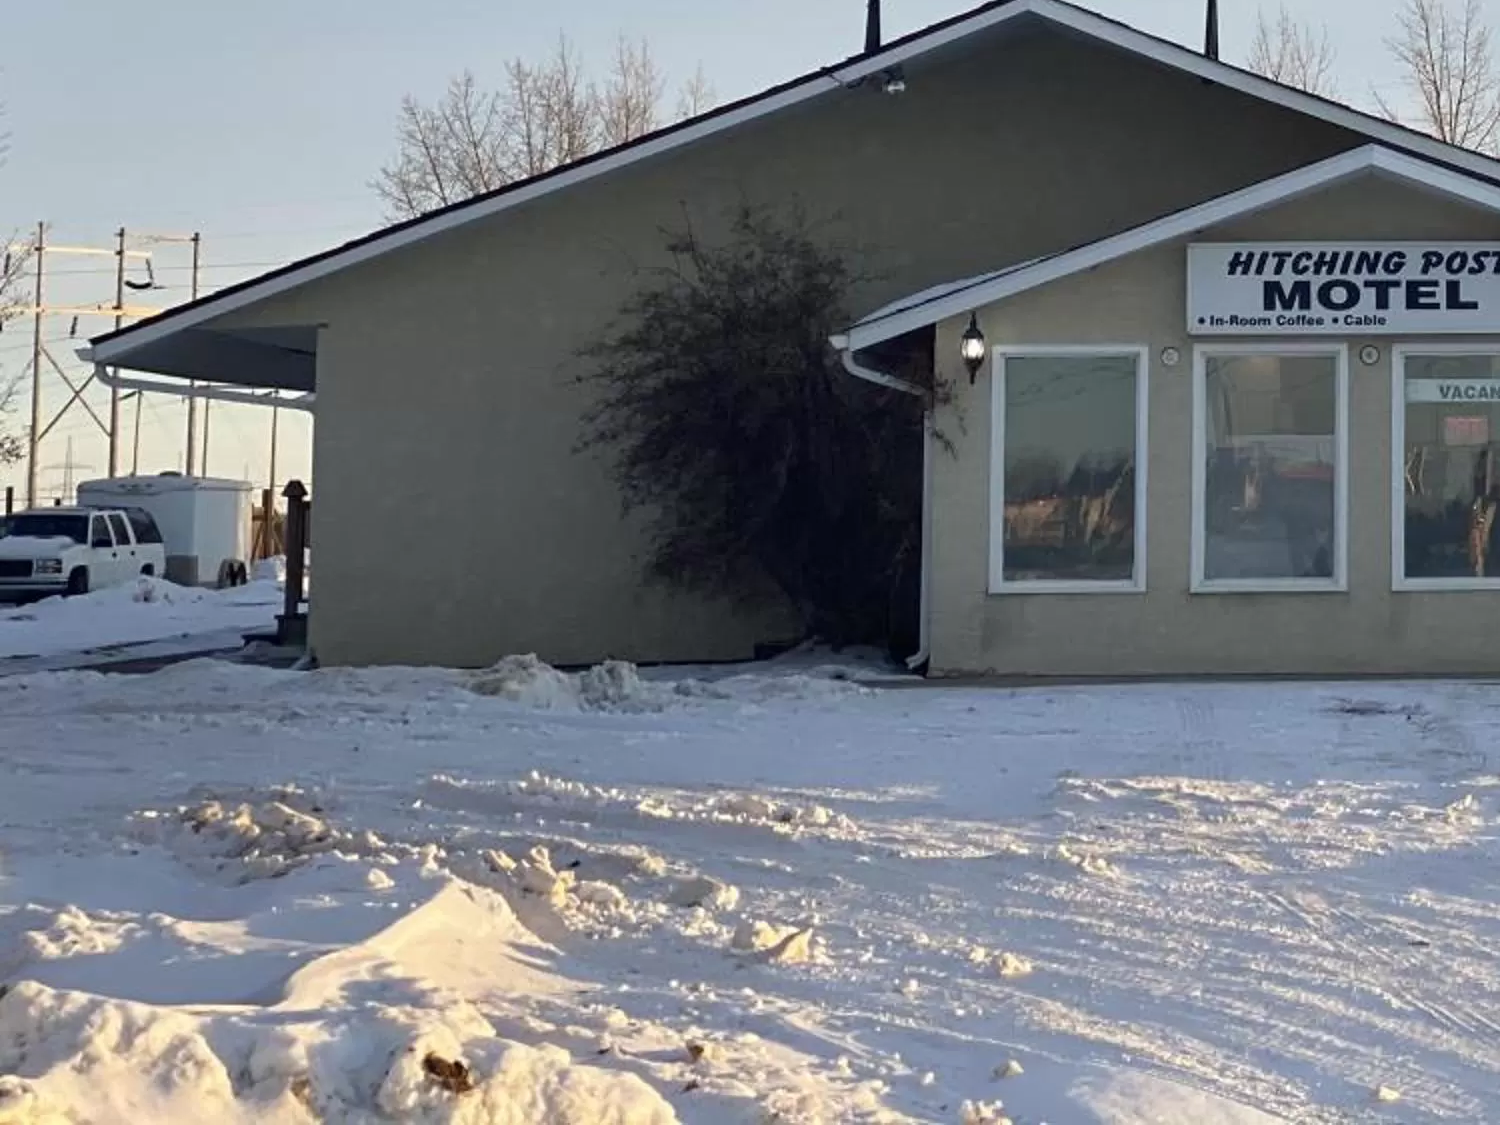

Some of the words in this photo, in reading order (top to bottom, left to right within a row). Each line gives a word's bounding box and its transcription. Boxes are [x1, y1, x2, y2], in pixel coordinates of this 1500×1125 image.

[1226, 250, 1407, 276] HITCHING
[1262, 279, 1479, 311] MOTEL
[1209, 314, 1271, 327] In-Room
[1276, 314, 1325, 327] Coffee
[1343, 314, 1387, 327] Cable
